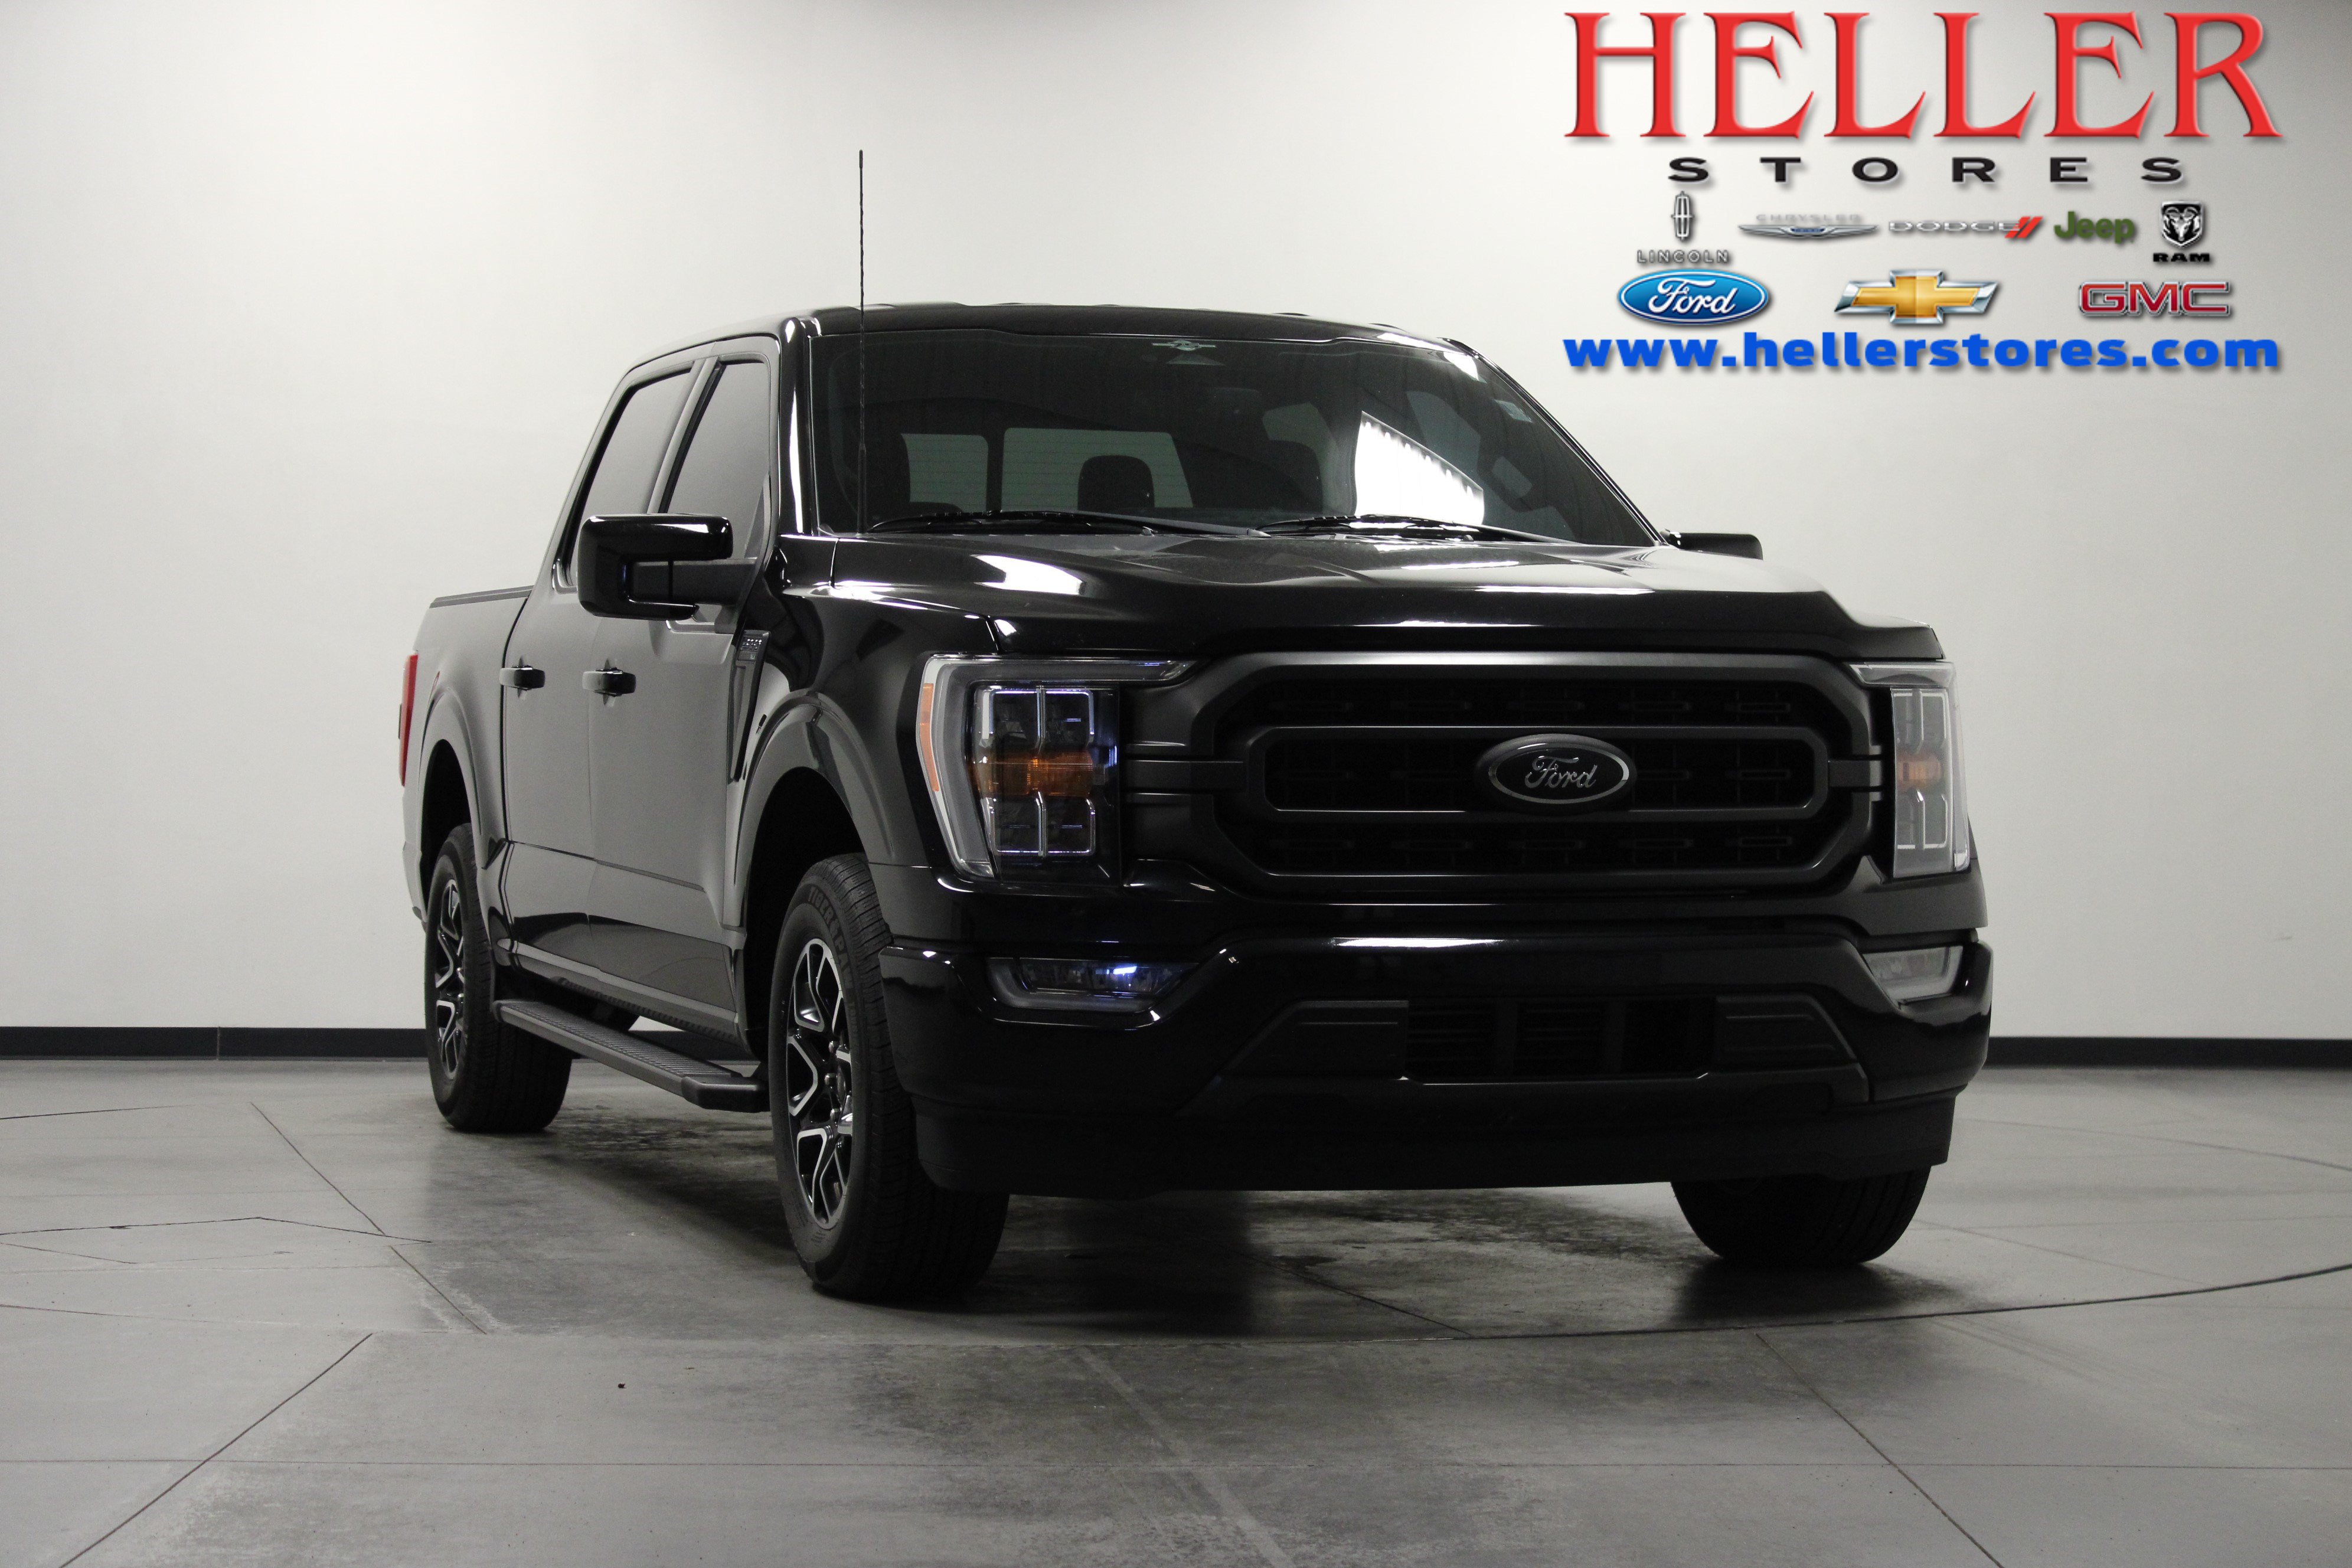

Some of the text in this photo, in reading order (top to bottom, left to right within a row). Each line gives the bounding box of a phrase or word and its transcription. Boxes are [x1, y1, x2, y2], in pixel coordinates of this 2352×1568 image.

[1524, 755, 1598, 789] Ford
[807, 886, 834, 924] TIGER
[834, 934, 854, 989] PAW
